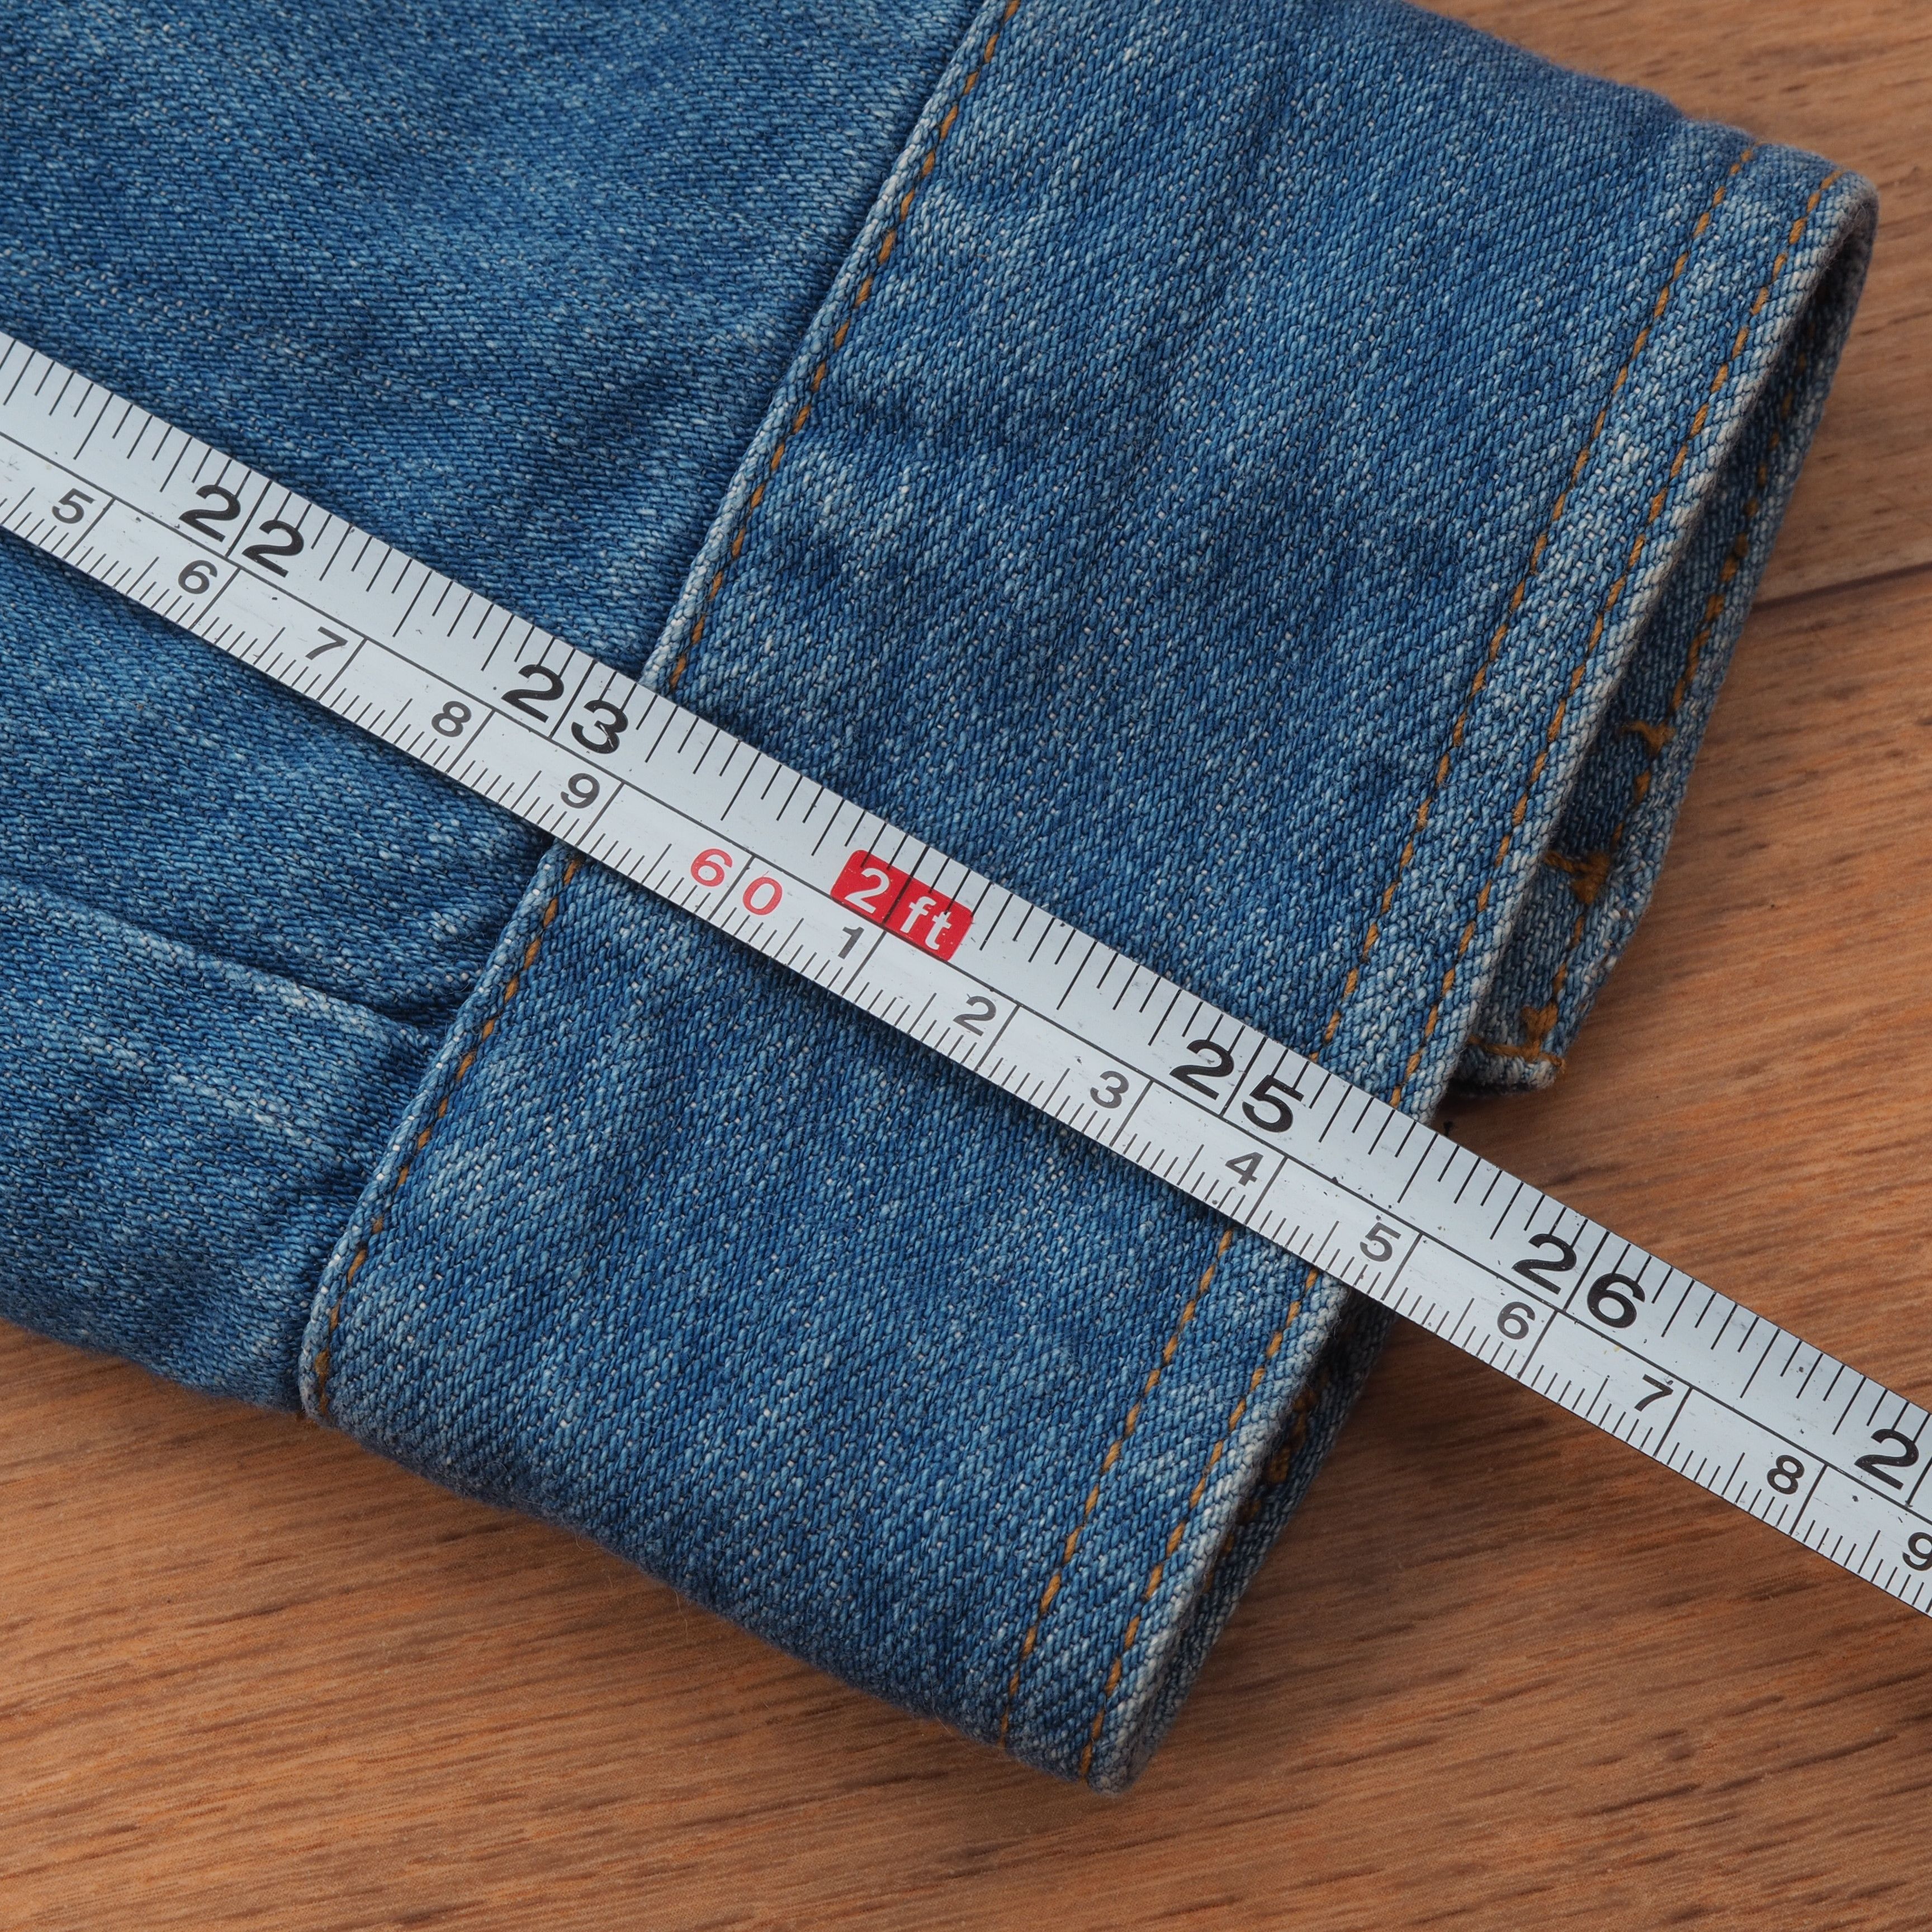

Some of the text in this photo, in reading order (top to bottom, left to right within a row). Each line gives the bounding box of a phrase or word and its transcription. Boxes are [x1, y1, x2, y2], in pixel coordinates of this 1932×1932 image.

[52, 488, 1932, 1571] 5 6 7 8 9 60 1 2 3 4 5 6 7 8 9
[178, 485, 305, 577] 22
[501, 665, 629, 754] 23
[1169, 1040, 1304, 1133] 25
[1512, 1234, 1645, 1328] 26
[1854, 1429, 1919, 1490] 2
